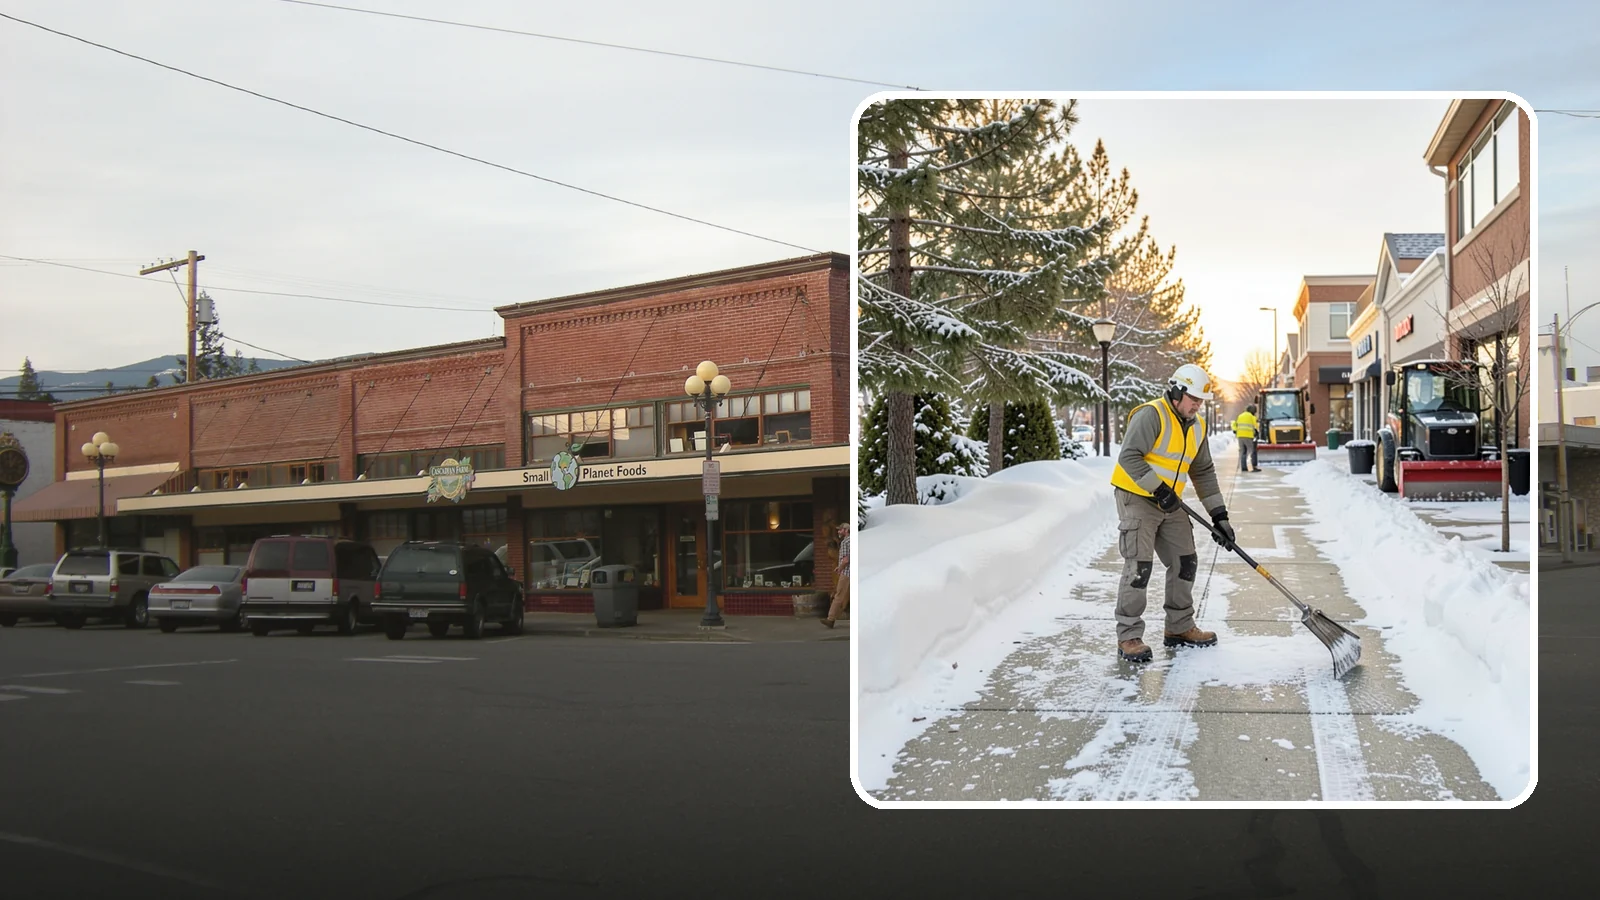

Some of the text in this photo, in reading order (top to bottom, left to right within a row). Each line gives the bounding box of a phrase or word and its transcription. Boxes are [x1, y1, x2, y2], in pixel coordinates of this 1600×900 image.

[431, 467, 455, 476] CASCADIAN
[523, 465, 647, 483] Small Planet Foods
